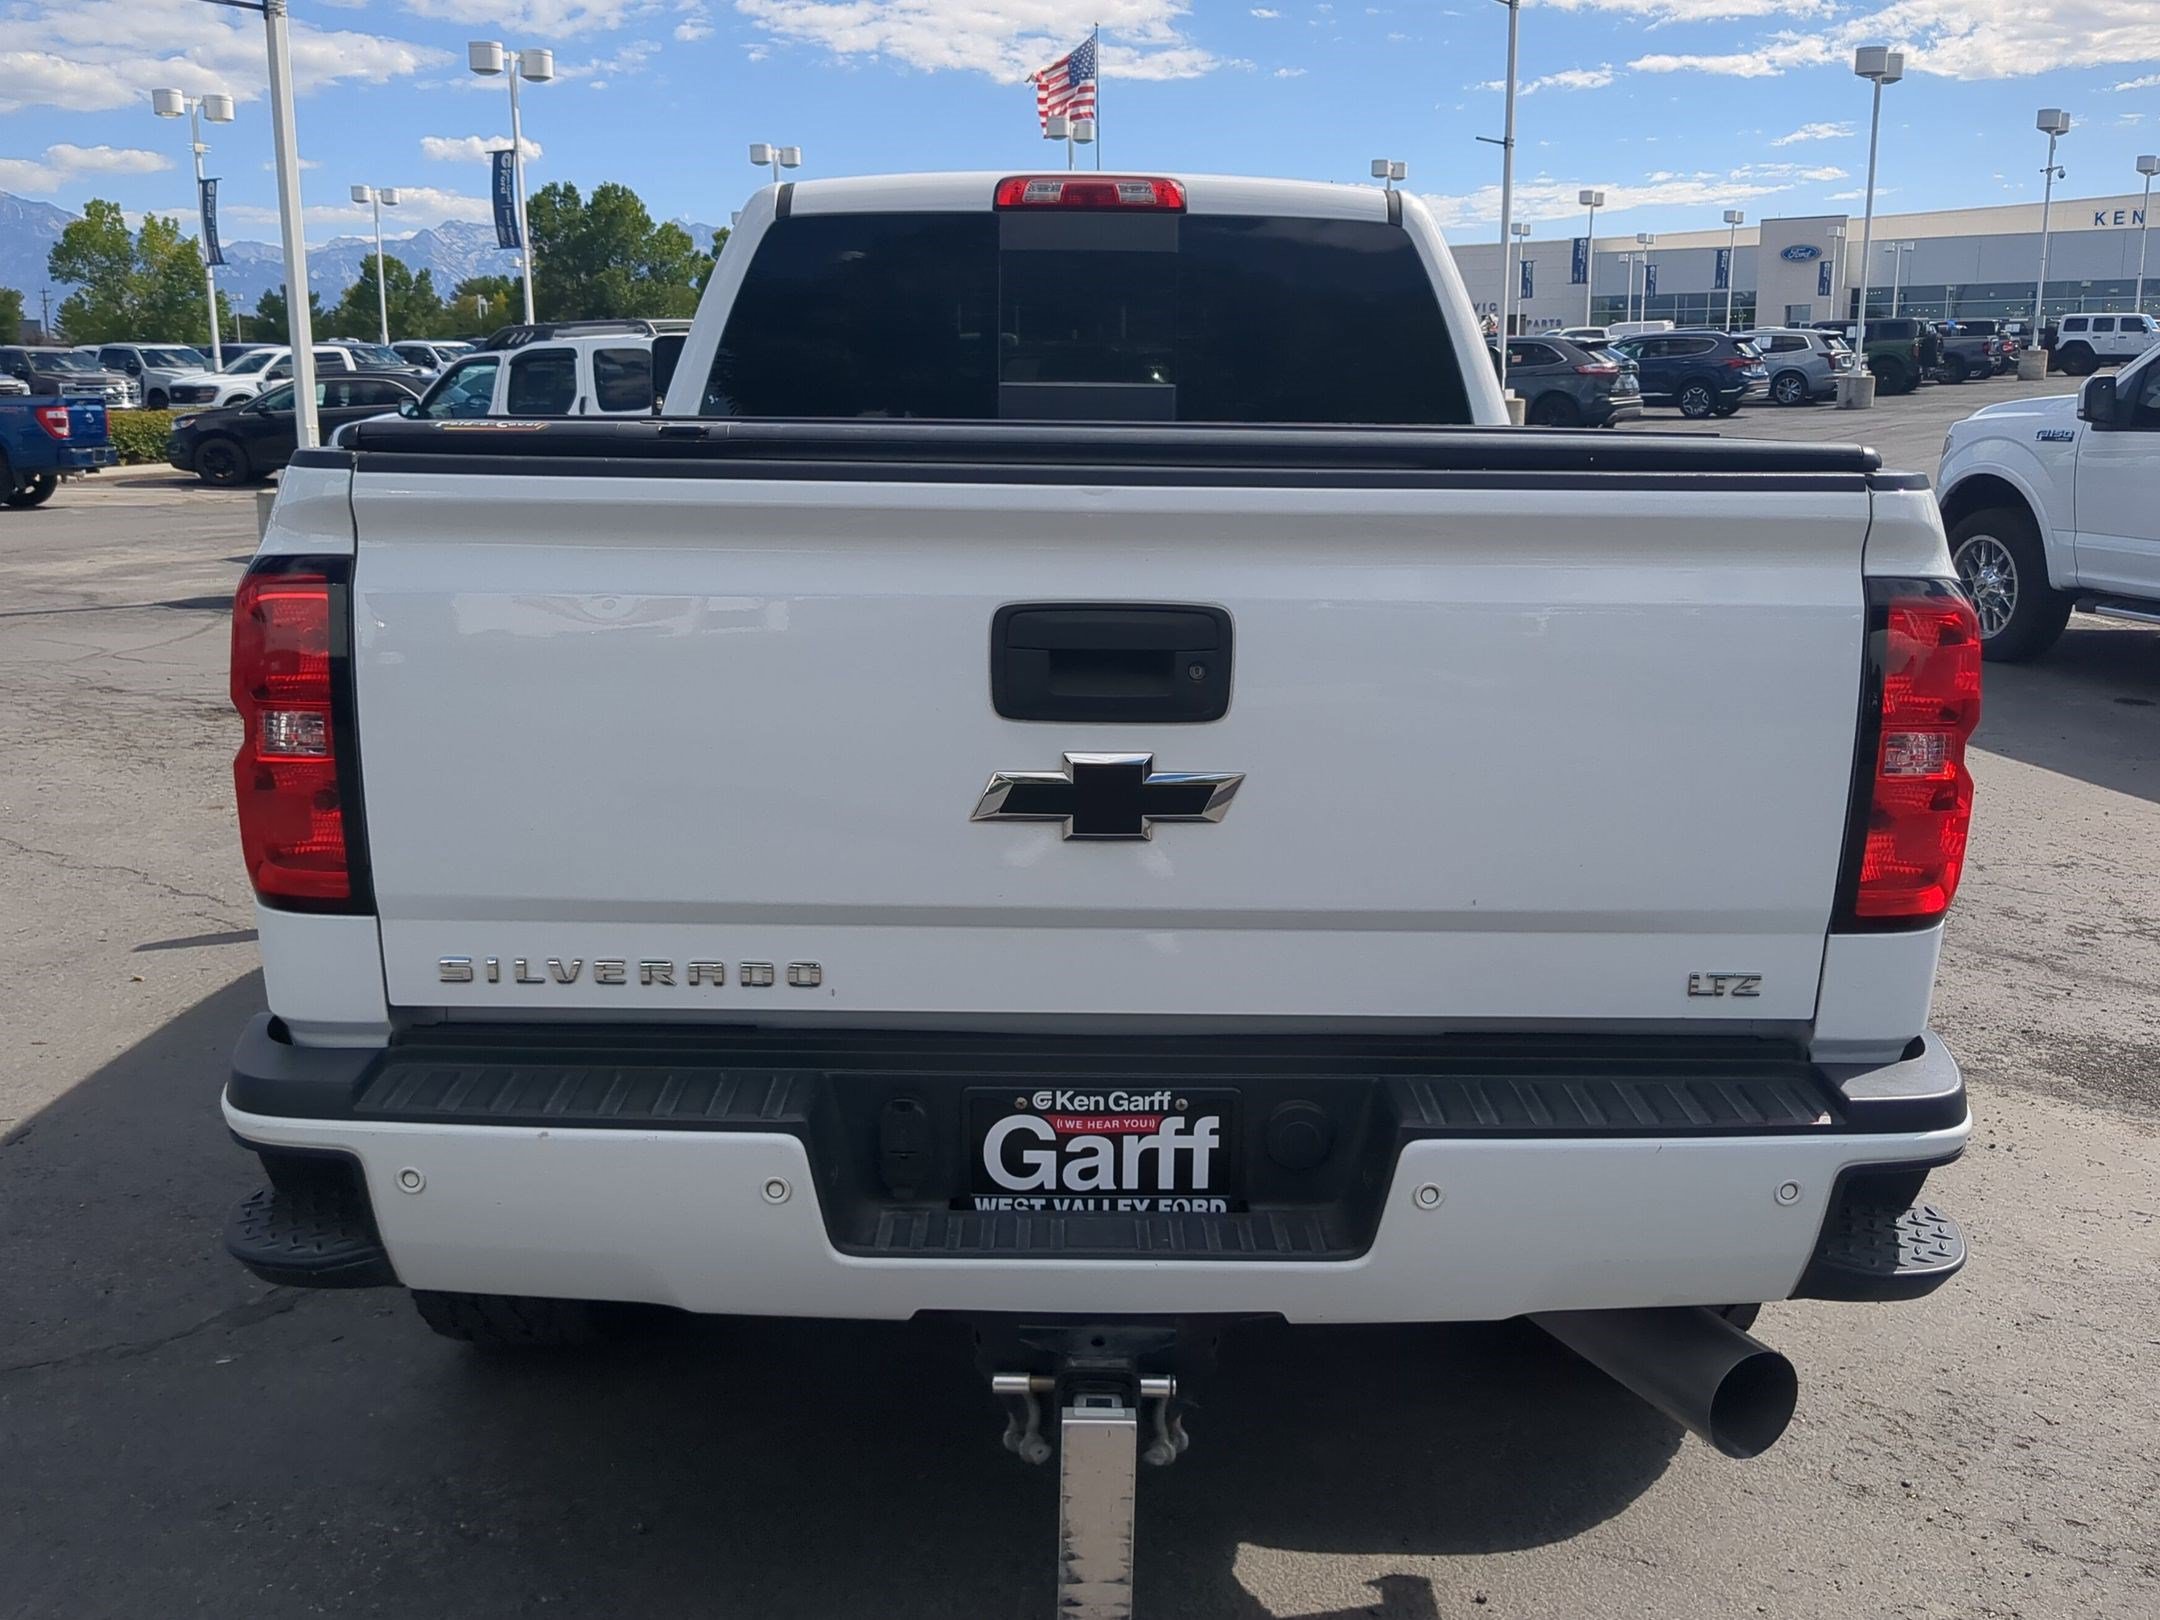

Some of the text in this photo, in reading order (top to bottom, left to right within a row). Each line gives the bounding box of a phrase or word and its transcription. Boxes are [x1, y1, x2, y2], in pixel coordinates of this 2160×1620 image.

[2094, 210, 2145, 226] KEN
[1526, 319, 1562, 328] PARTS
[438, 956, 824, 988] SILVERADO
[1687, 972, 1762, 996] LTZ
[1055, 1091, 1172, 1111] Ken Garff
[1065, 1118, 1147, 1129] WE HEAR YOU
[983, 1114, 1220, 1191] Garff
